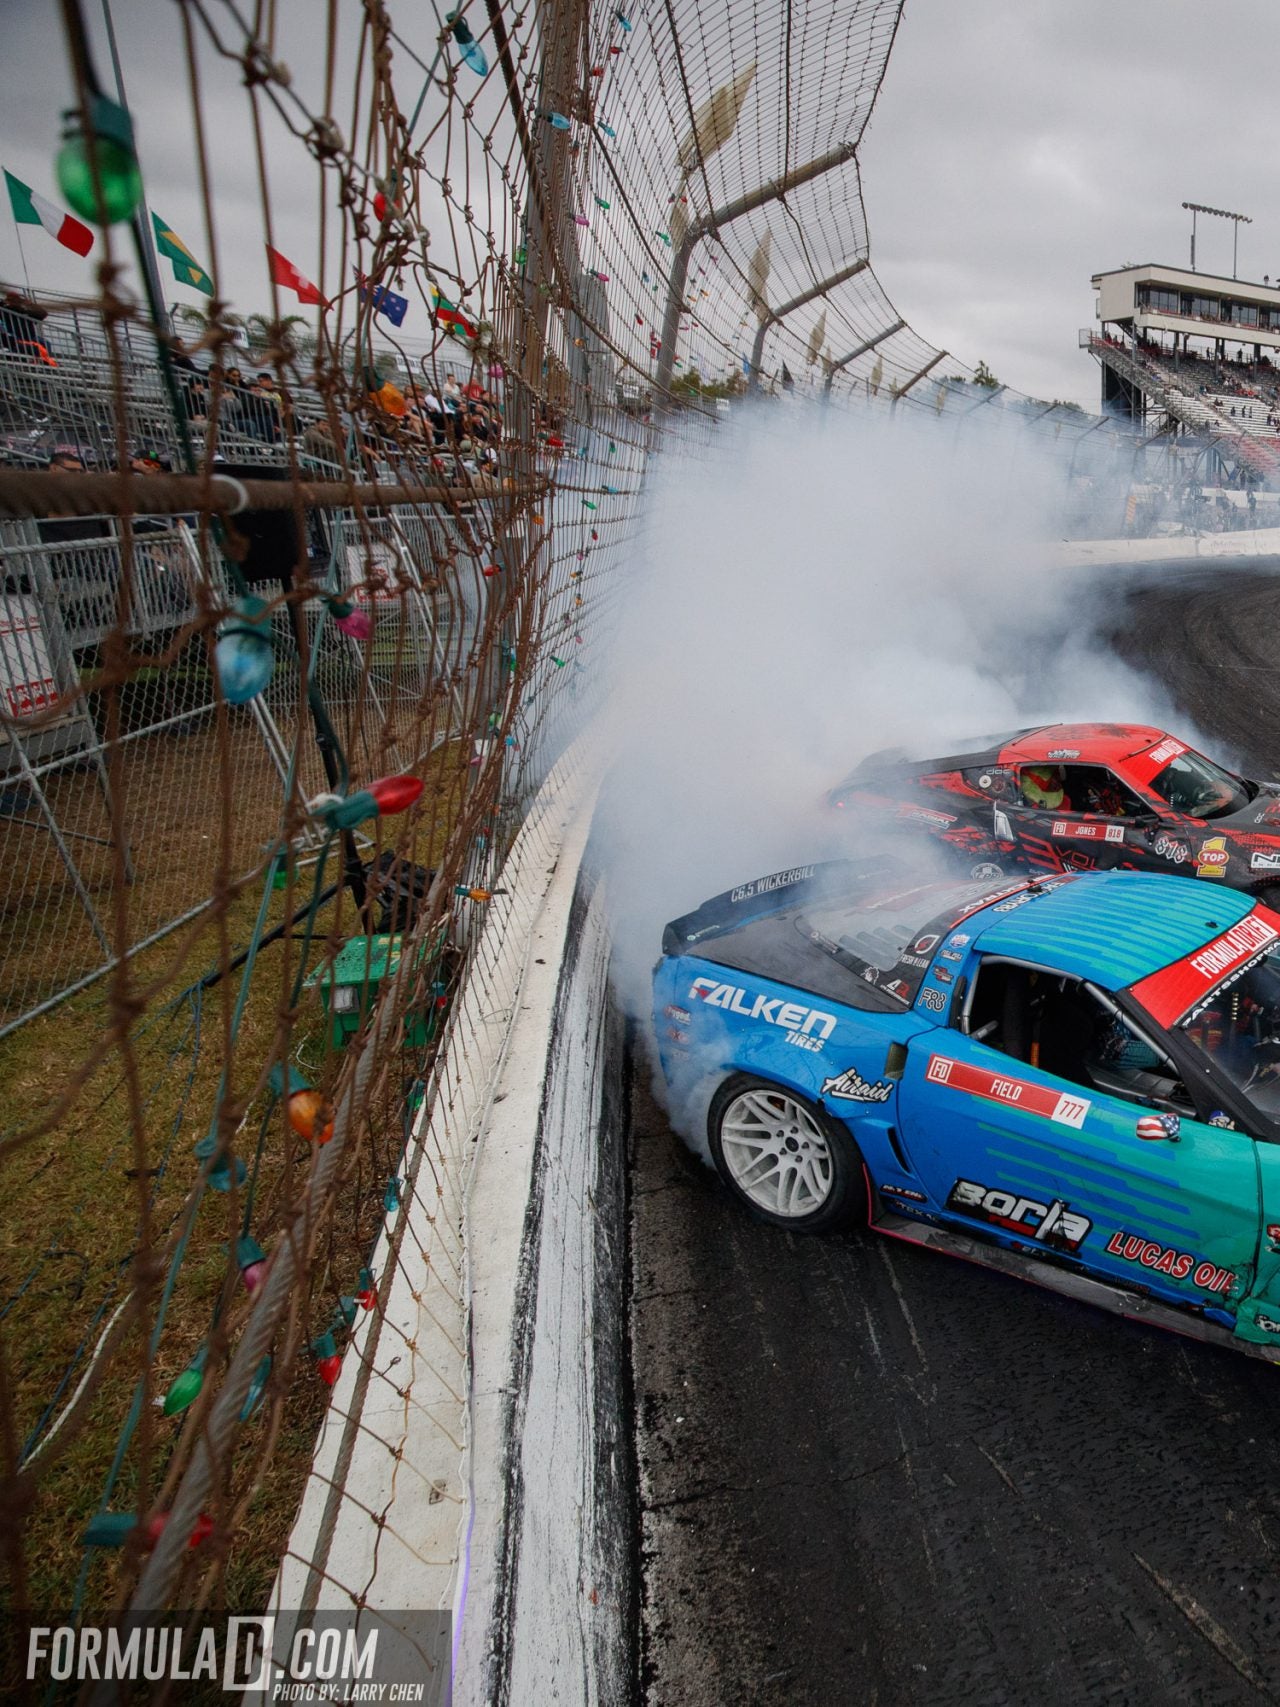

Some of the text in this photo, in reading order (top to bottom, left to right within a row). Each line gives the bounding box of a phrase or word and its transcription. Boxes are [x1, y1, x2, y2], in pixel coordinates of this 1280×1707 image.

[1075, 826, 1096, 836] JONES
[1202, 852, 1225, 864] TOP
[757, 866, 815, 894] WICKERBILL
[688, 977, 838, 1040] FALKEN
[784, 1030, 825, 1053] TIRES
[822, 1068, 893, 1101] Airaid
[933, 1062, 1085, 1120] FD FIELD 777
[1107, 1232, 1240, 1295] LUCAS OIL
